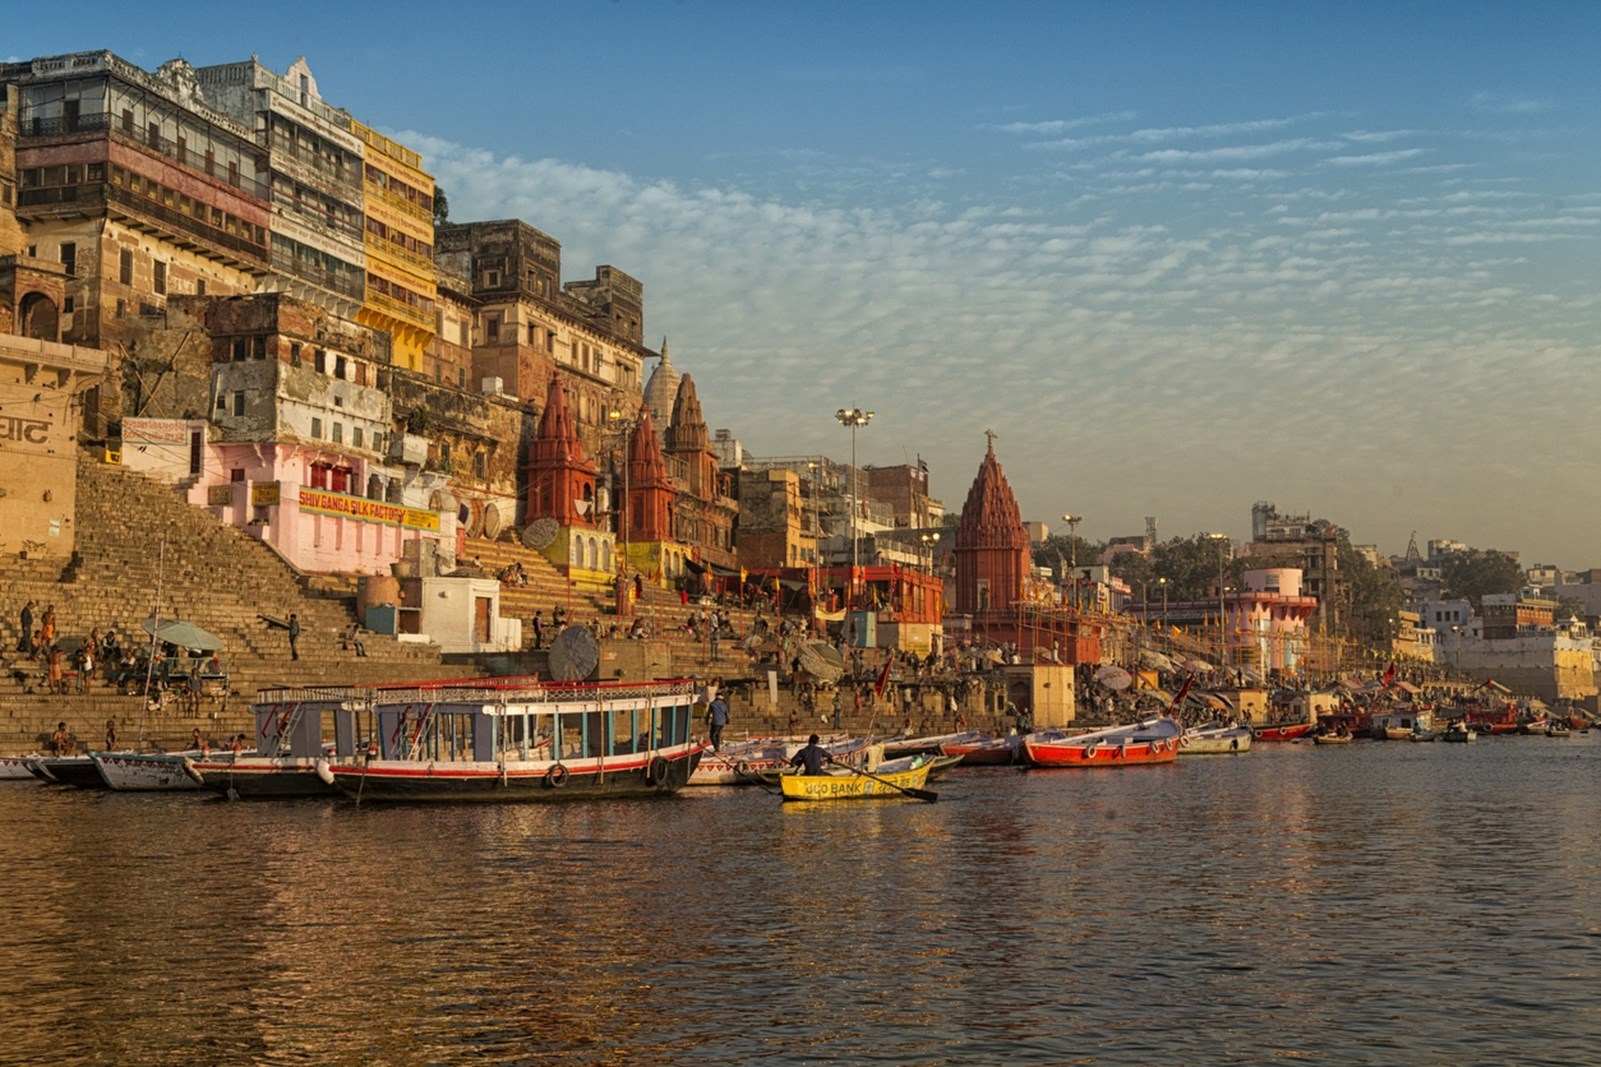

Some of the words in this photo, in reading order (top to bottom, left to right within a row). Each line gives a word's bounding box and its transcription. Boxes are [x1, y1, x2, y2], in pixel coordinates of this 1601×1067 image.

[299, 491, 321, 507] SHIV
[321, 495, 350, 512] GANGA
[350, 500, 369, 516] SILK
[369, 503, 406, 522] FACTORY
[805, 783, 828, 794] UCO
[831, 783, 862, 793] BANK
